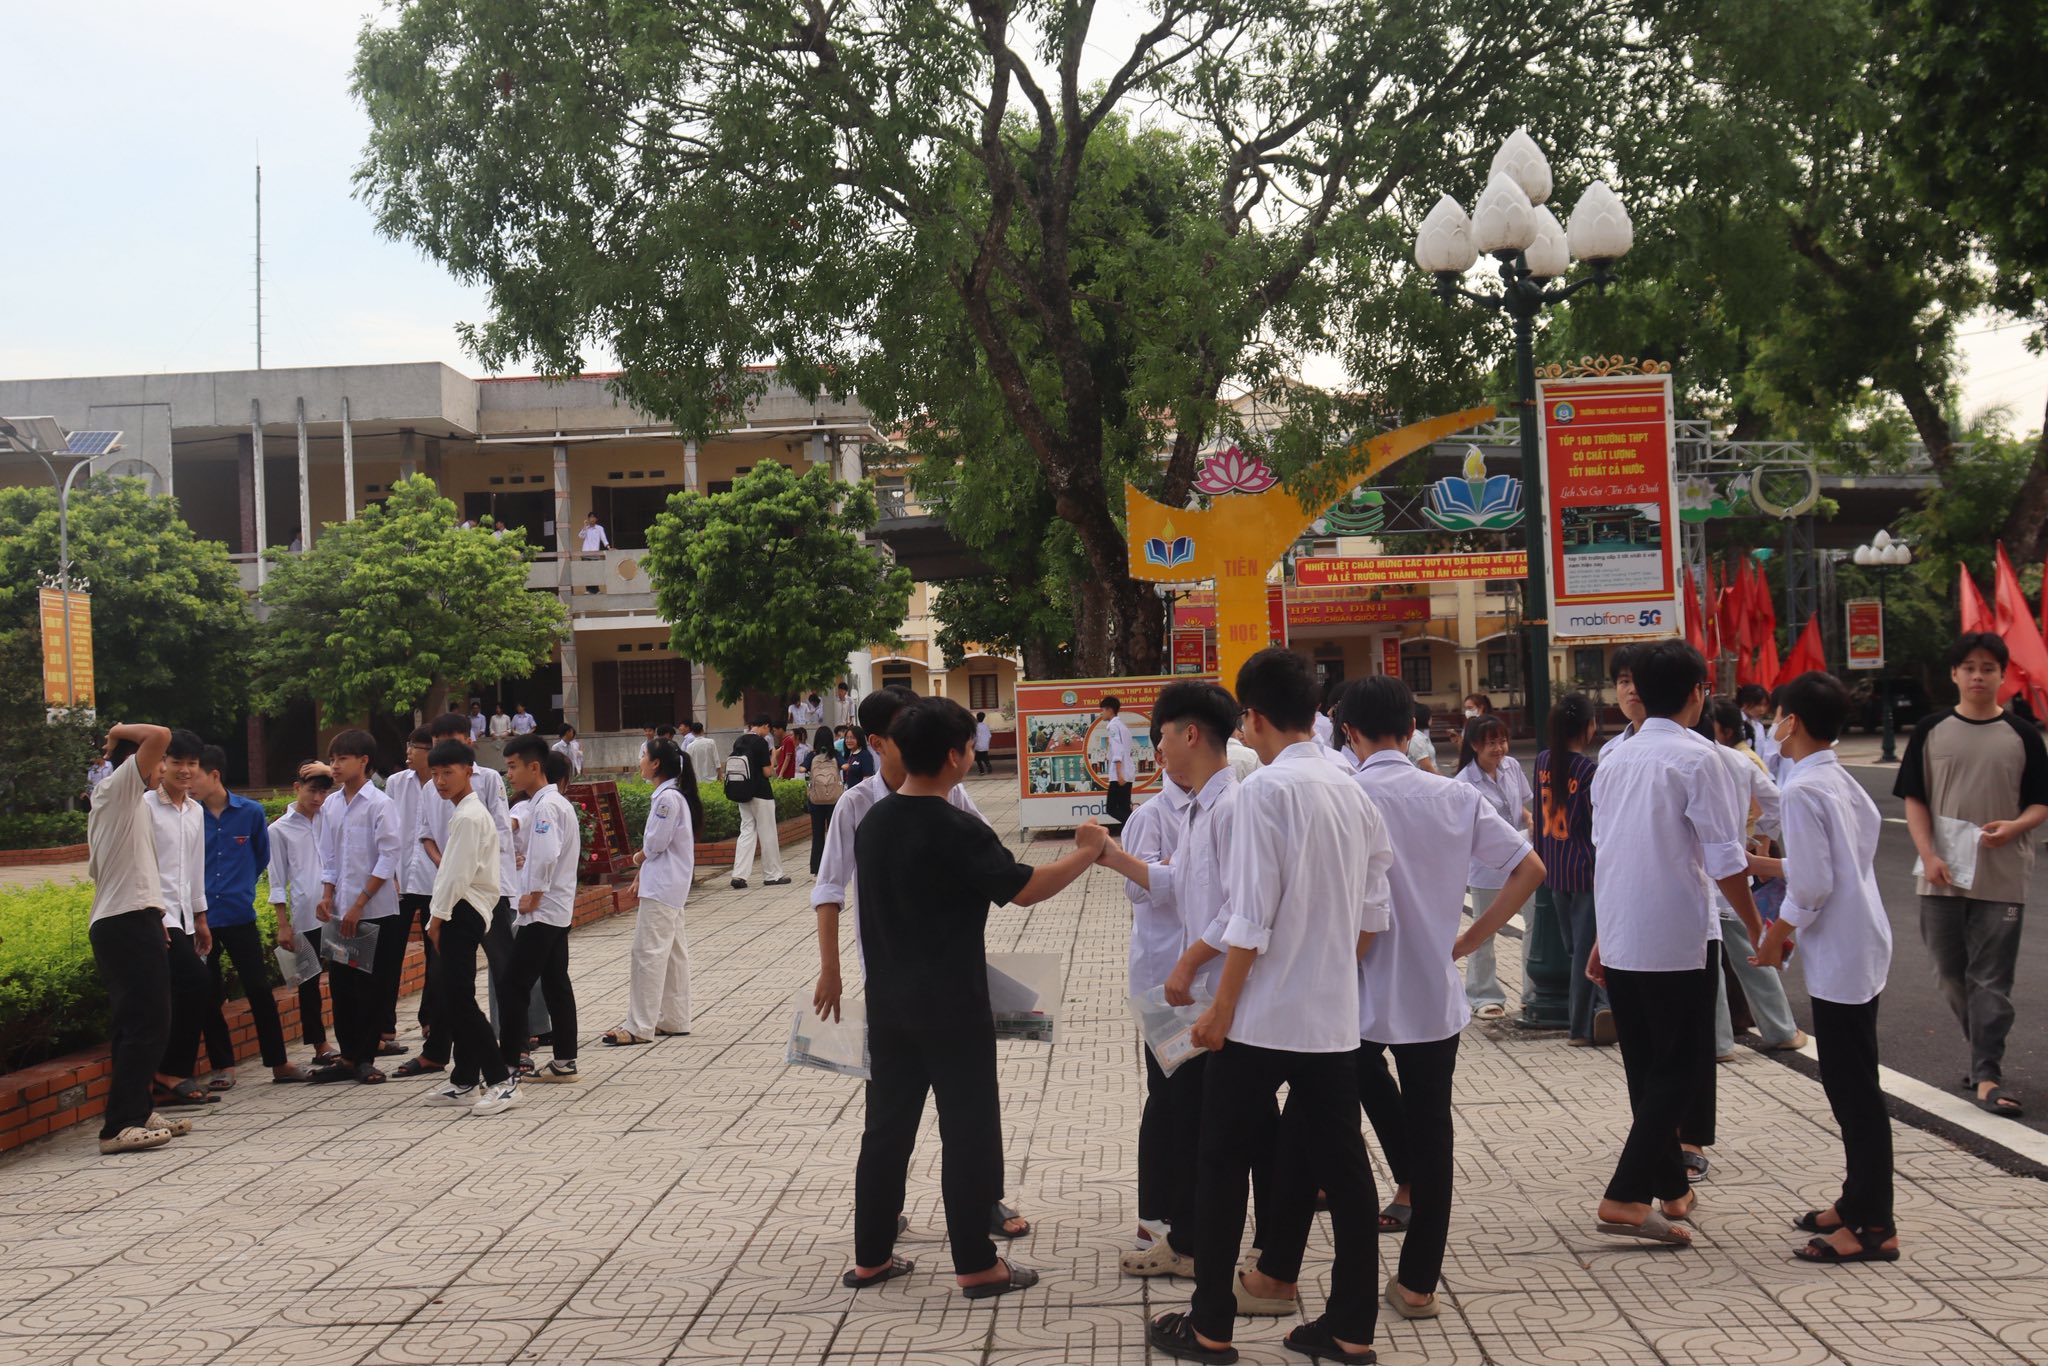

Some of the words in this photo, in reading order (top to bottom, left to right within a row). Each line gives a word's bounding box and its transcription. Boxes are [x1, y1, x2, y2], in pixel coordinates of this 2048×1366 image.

[1577, 435, 1592, 446] 100
[1594, 431, 1627, 445] TRƯỜNG
[1629, 432, 1648, 443] THPT
[1572, 449, 1584, 461] CÓ
[1586, 447, 1607, 460] CHẤT
[1609, 448, 1637, 462] LƯỢNG
[1568, 464, 1583, 477] TỐT
[1585, 463, 1607, 476] NHẤT
[1608, 461, 1620, 475] CẢ
[1622, 462, 1645, 475] NƯỚC
[1223, 556, 1258, 576] TIÊN
[1305, 561, 1330, 573] NHIỆT
[1332, 560, 1350, 572] LIỆT
[1351, 559, 1375, 570] CHÀO
[1376, 558, 1403, 569] MỪNG
[1405, 557, 1422, 568] CÁC
[1443, 556, 1453, 567] VỊ
[1454, 555, 1469, 566] ĐẠI
[1470, 554, 1490, 565] BIỂU
[1493, 554, 1504, 564] VỀ
[1506, 553, 1519, 564] DỰ
[1327, 572, 1339, 582] VÀ
[1340, 571, 1350, 582] LỄ
[1352, 569, 1386, 581] TRƯỞNG
[1388, 569, 1419, 580] THÀNH,
[1422, 569, 1435, 578] TRI
[1437, 568, 1450, 577] ÂN
[1452, 565, 1469, 577] CỦA
[1471, 567, 1488, 578] HỌC
[1490, 566, 1512, 576] SINH
[1513, 564, 1528, 574] LỚ
[1326, 605, 1344, 613] BA
[1570, 611, 1635, 627] mobifone
[1638, 608, 1662, 627] 5G
[1229, 623, 1258, 645] HỌC
[1126, 687, 1142, 695] THPT
